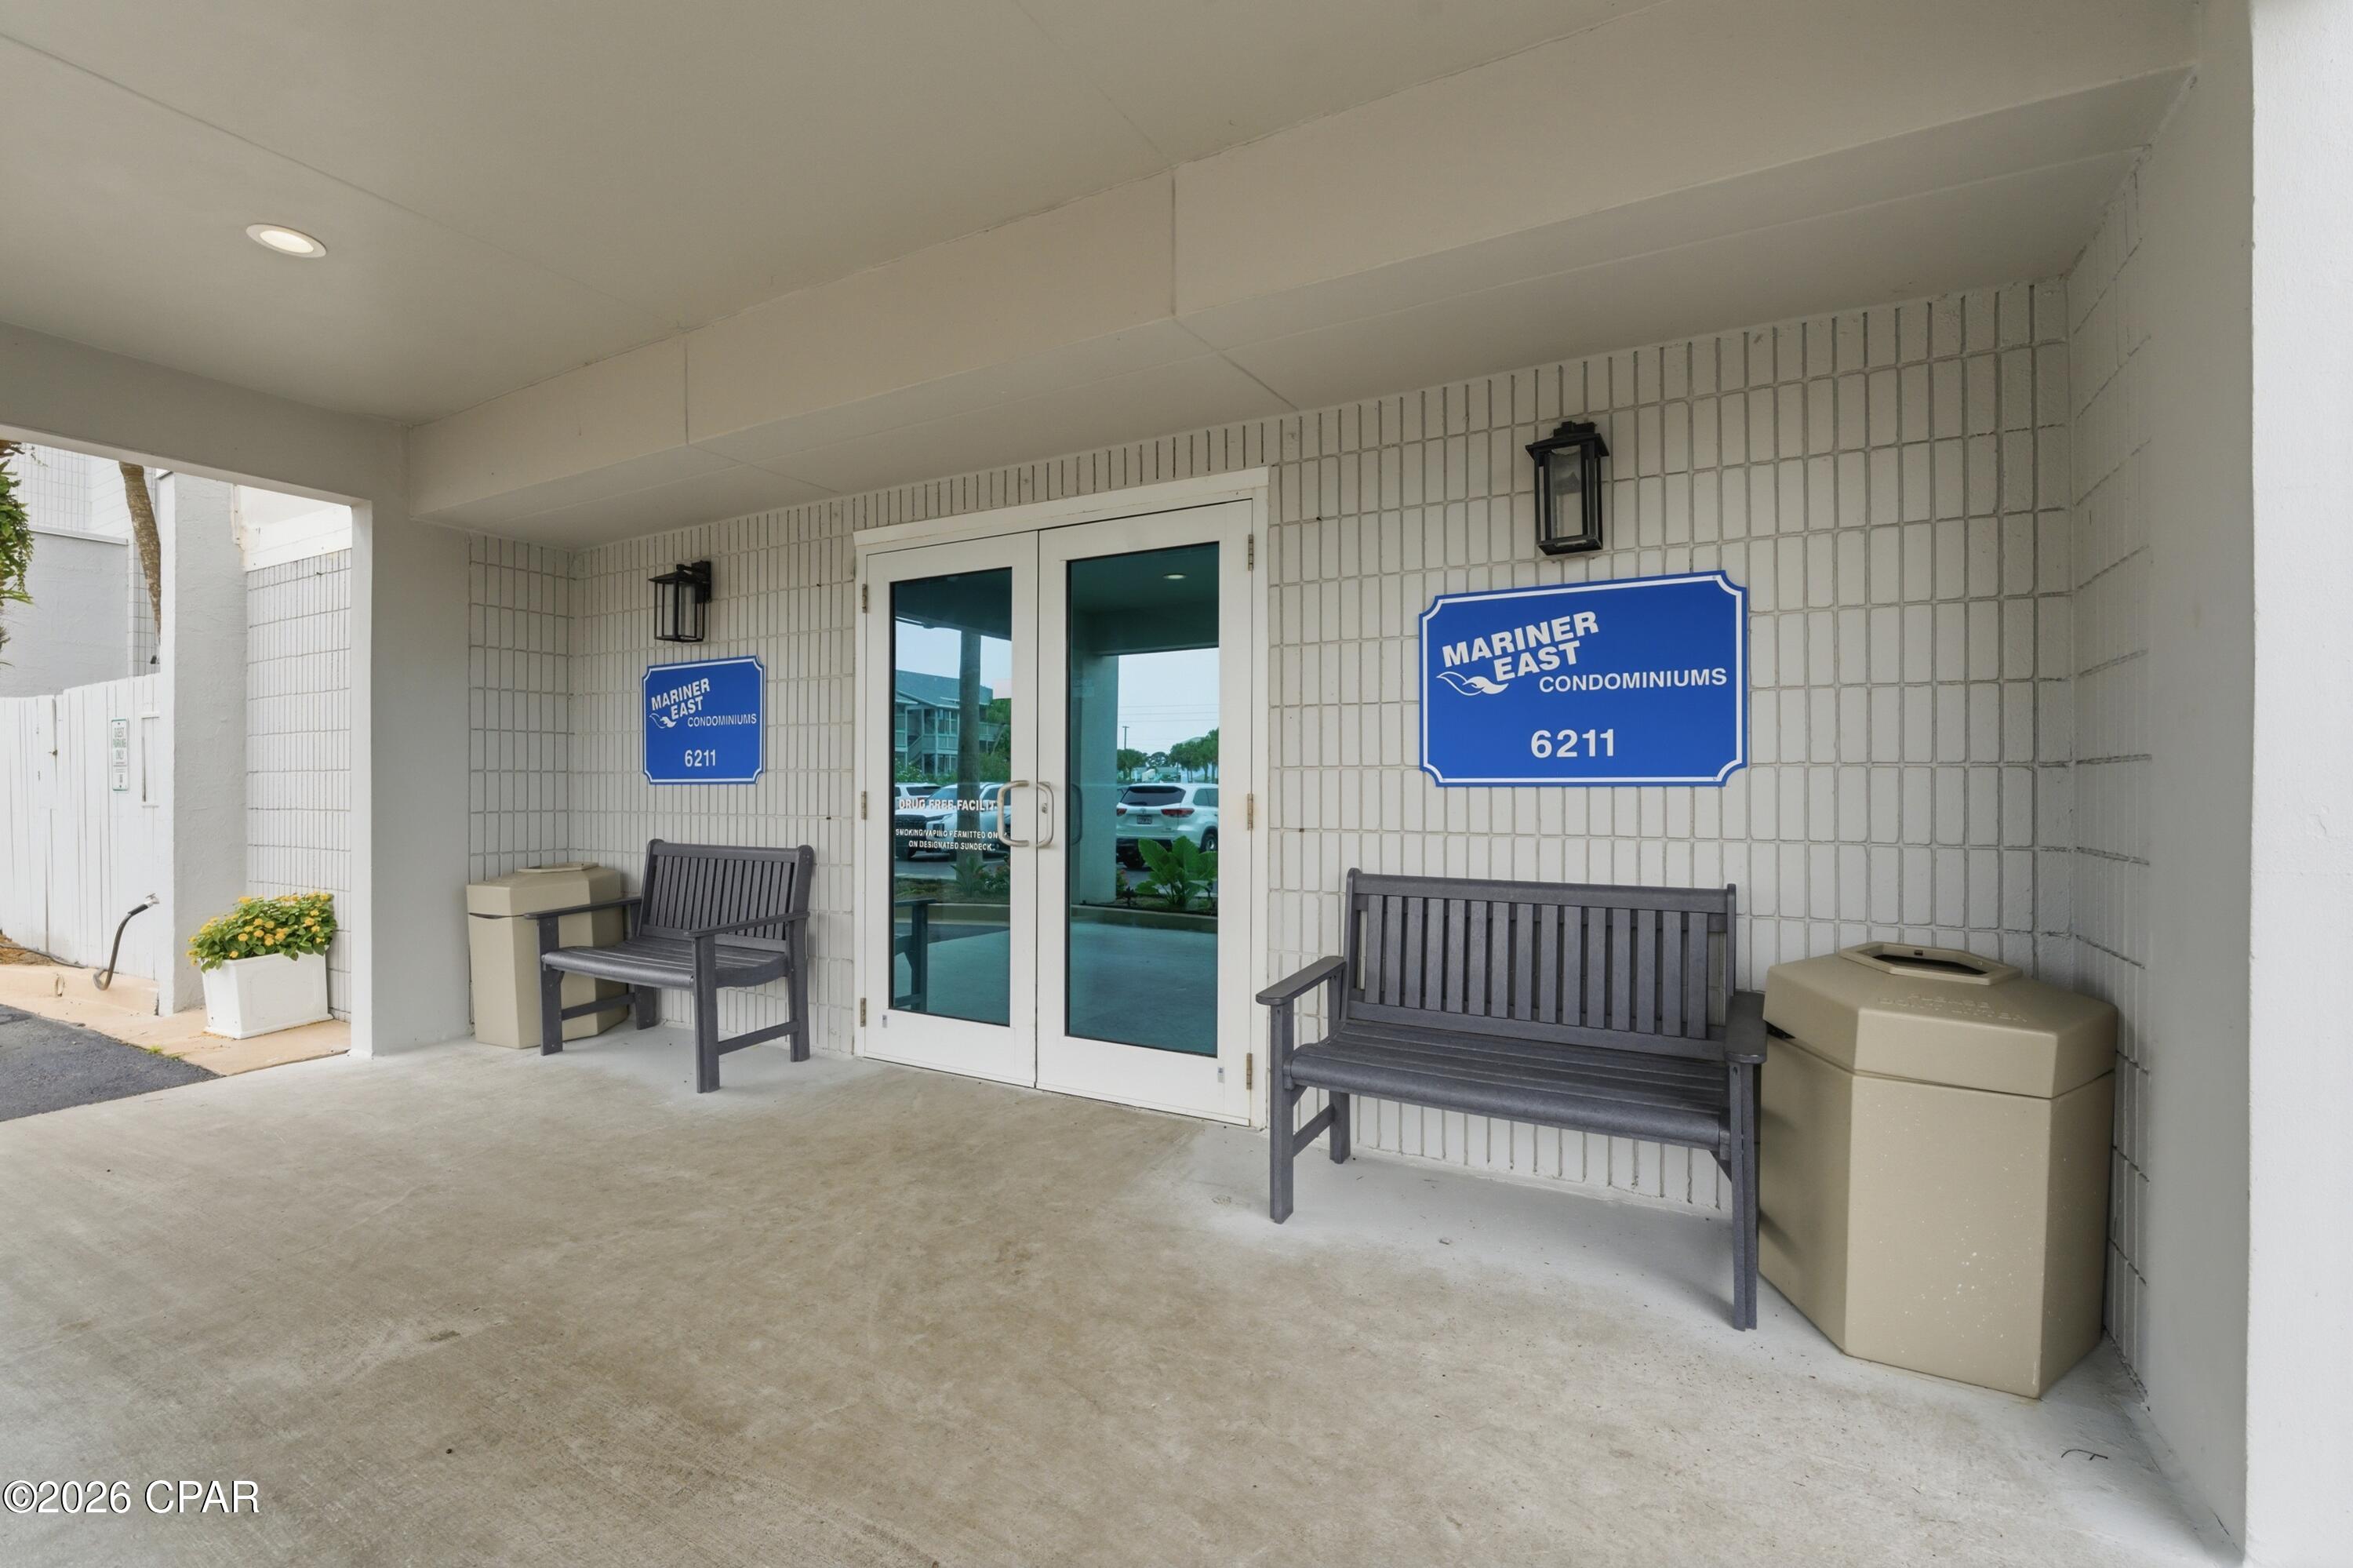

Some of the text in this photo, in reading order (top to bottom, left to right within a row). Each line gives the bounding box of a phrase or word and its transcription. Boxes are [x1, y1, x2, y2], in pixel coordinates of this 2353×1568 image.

[1442, 610, 1599, 668] MARINER
[1493, 640, 1580, 682] EAST
[1539, 668, 1727, 693] CONDOMINIUMS
[651, 678, 711, 711] MARINER
[671, 696, 704, 720] EAST
[687, 713, 758, 727] CONDOMINIUMS
[1530, 729, 1615, 759] 6211
[685, 749, 716, 767] 6211
[899, 799, 998, 811] DRUG FREE FACILIT
[919, 841, 958, 849] DESIGNATED
[949, 830, 986, 839] PERMITTED
